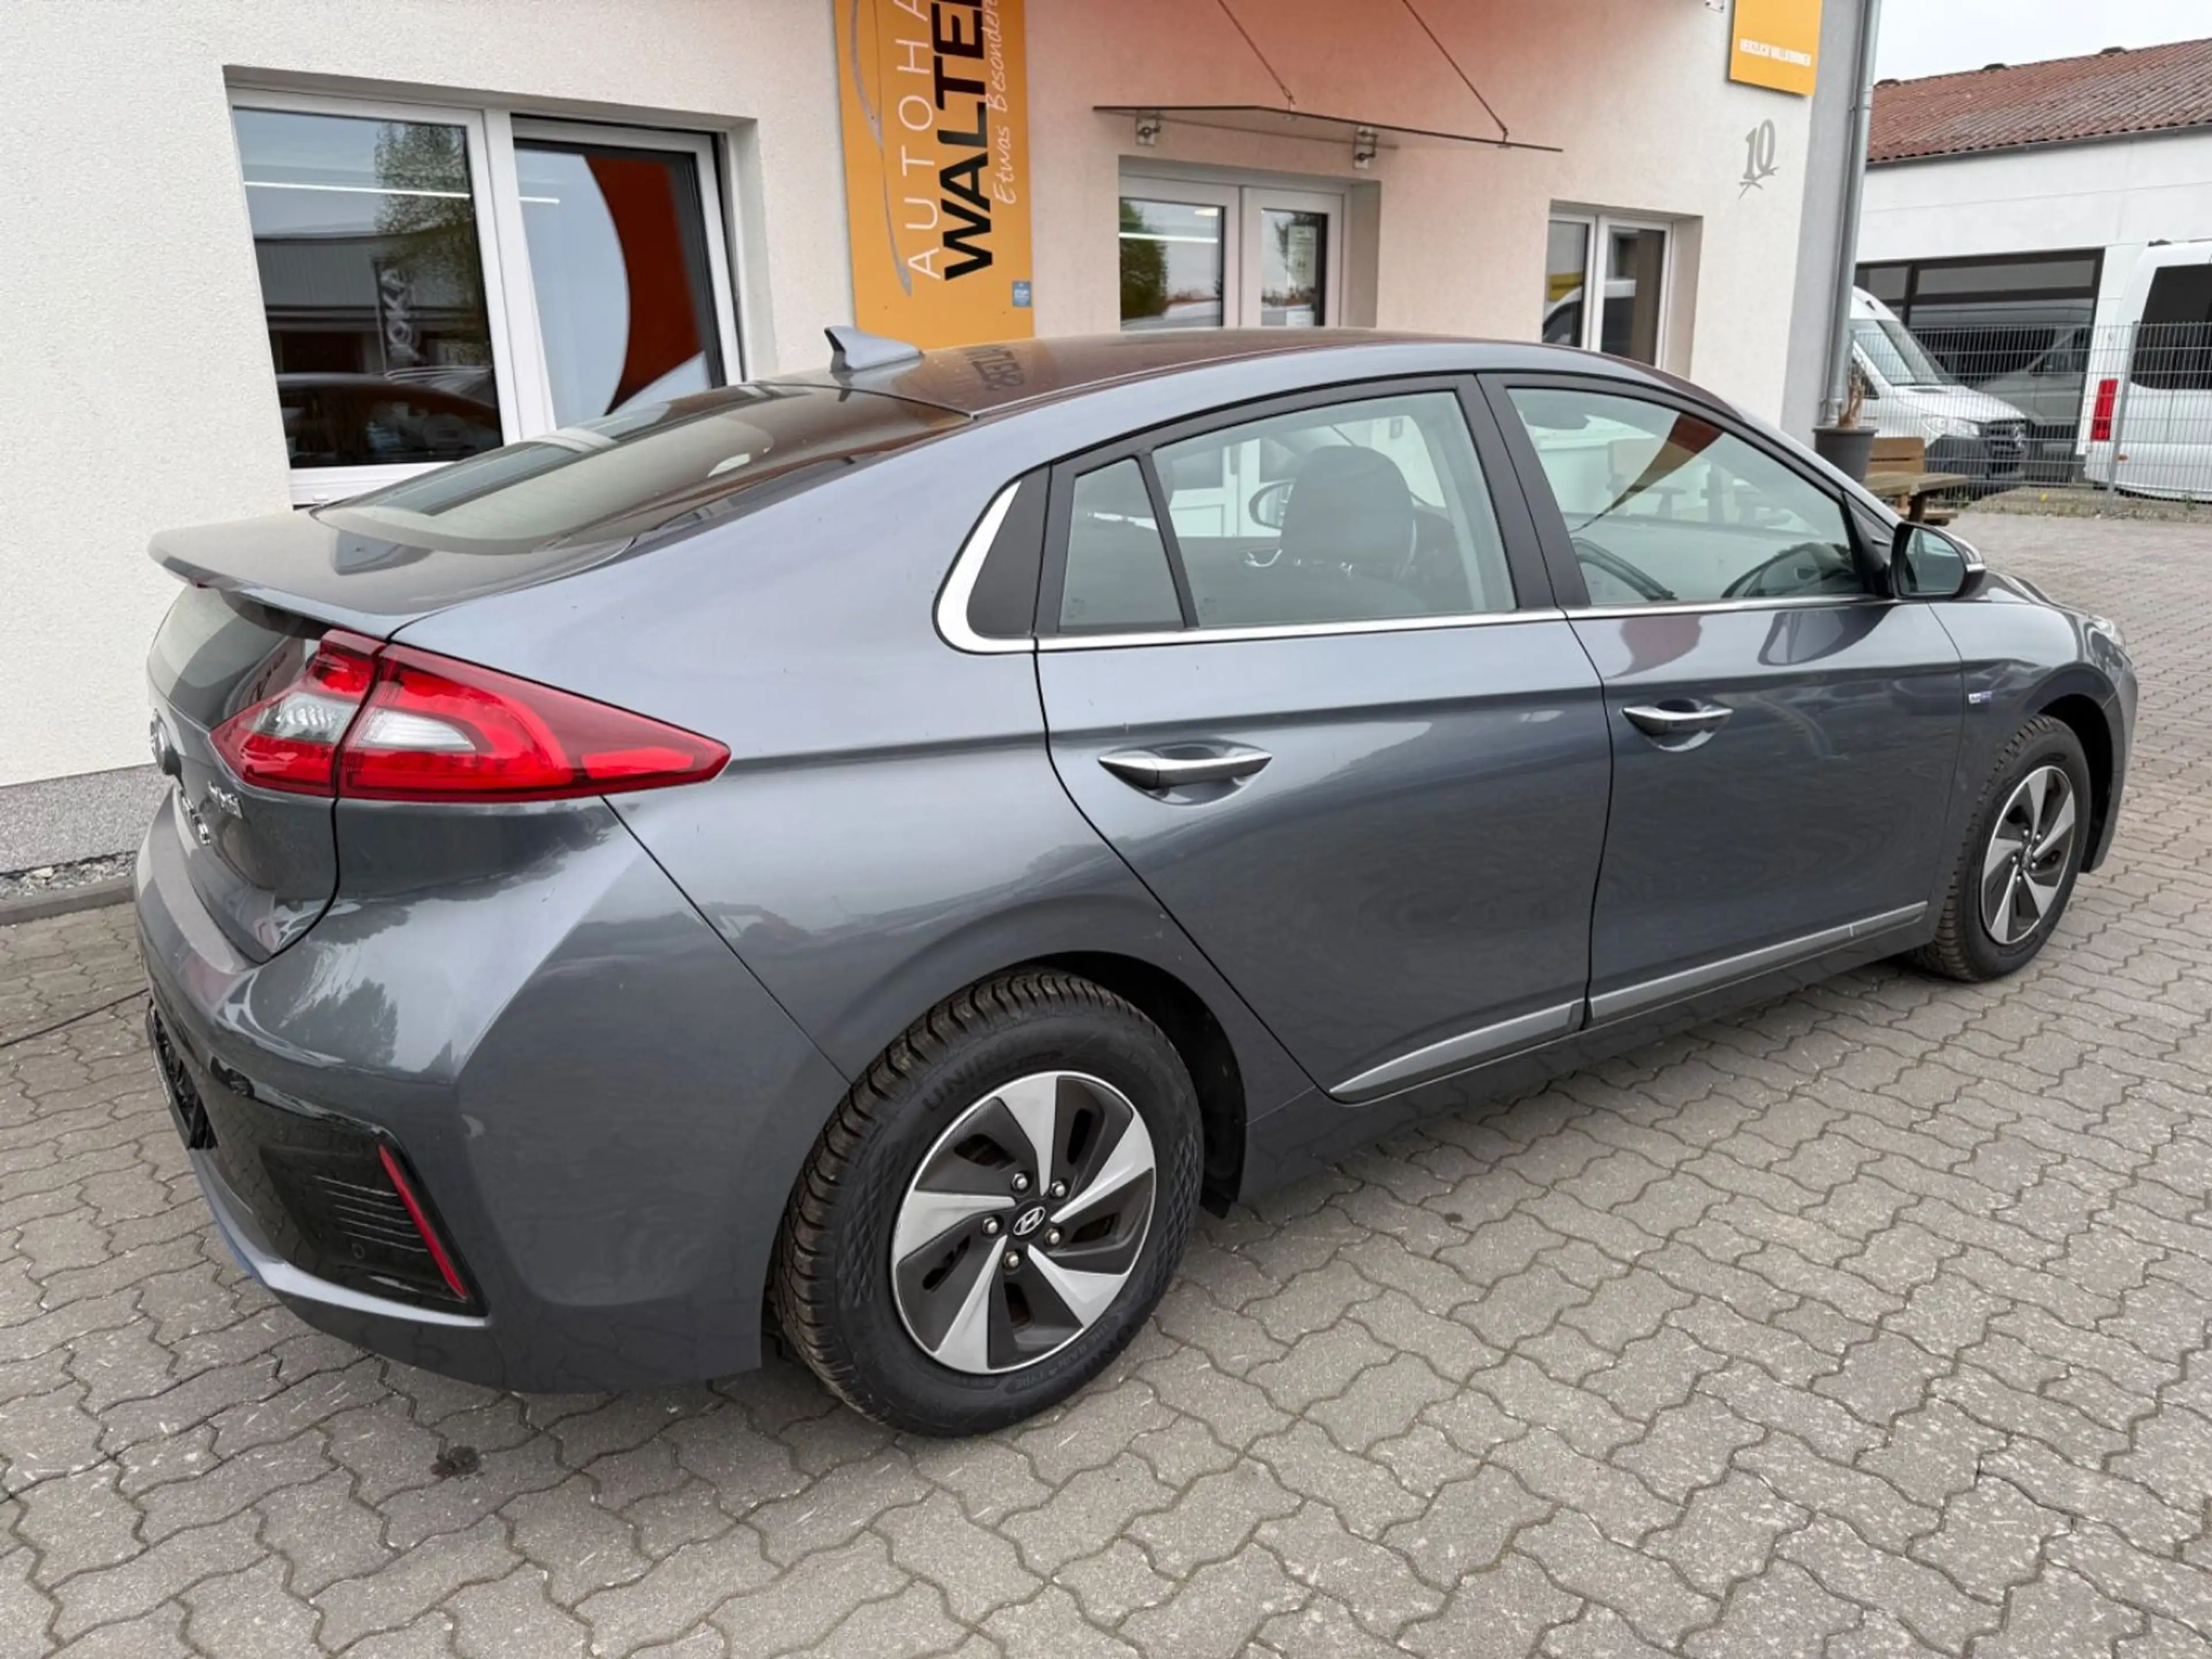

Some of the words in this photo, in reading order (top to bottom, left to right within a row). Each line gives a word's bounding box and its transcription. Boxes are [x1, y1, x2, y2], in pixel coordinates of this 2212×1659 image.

[930, 0, 993, 281] WALTE
[992, 125, 1017, 204] Etwas
[1741, 119, 1778, 183] 10
